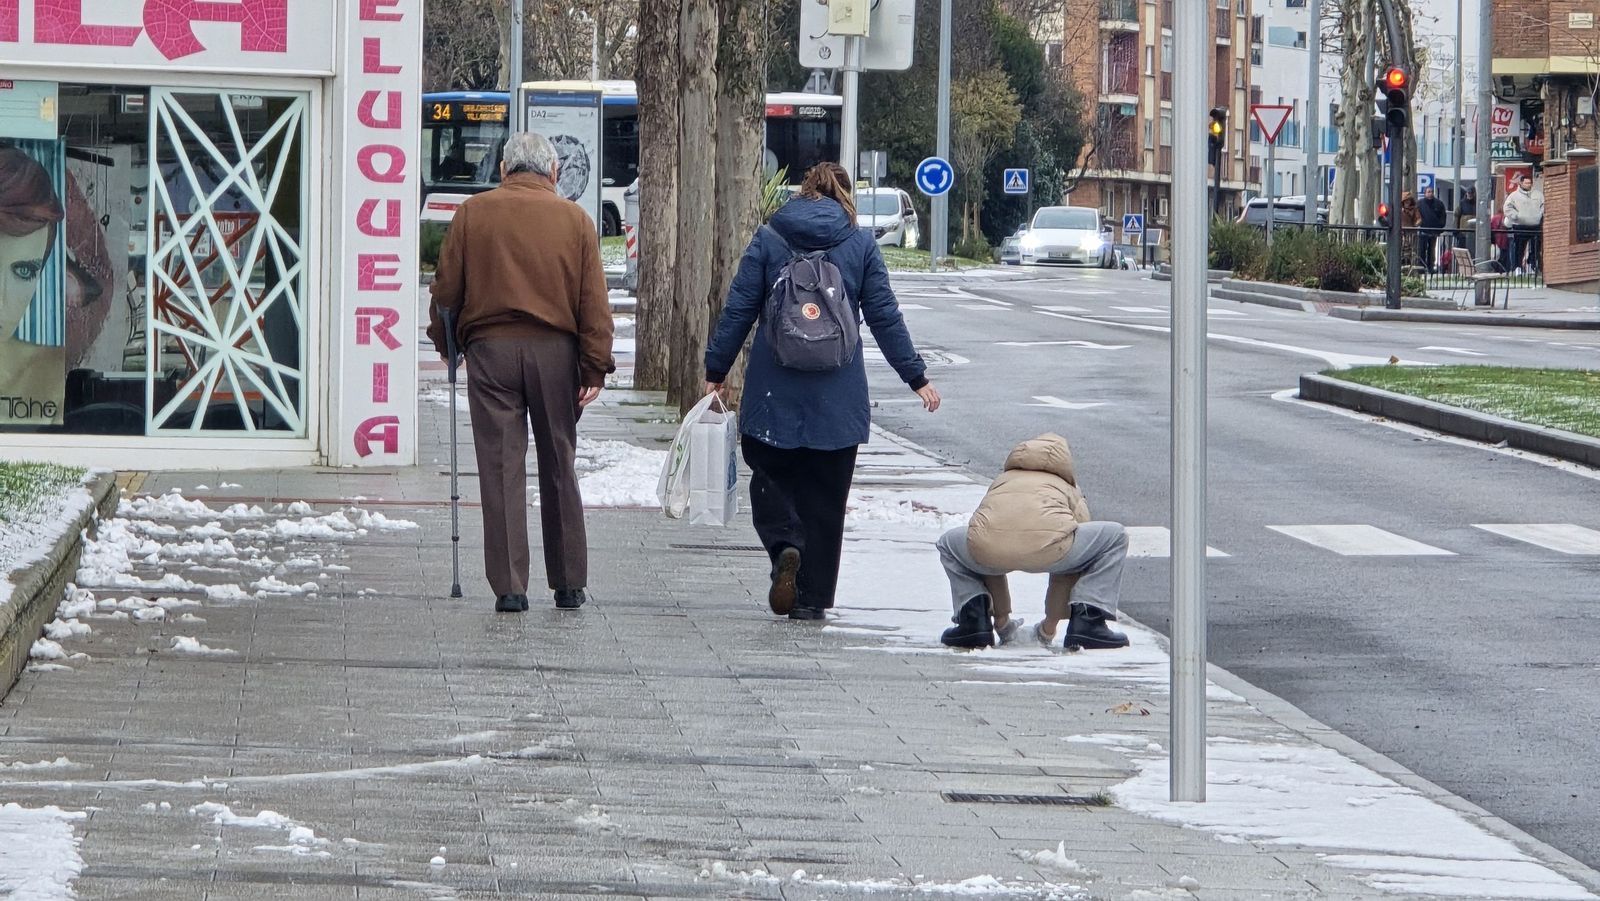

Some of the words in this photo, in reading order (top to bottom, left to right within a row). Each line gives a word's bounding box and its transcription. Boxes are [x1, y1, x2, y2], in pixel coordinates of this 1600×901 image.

[0, 0, 288, 61] LA
[433, 103, 451, 120] 34
[1419, 174, 1432, 194] P
[0, 396, 57, 419] Tahe
